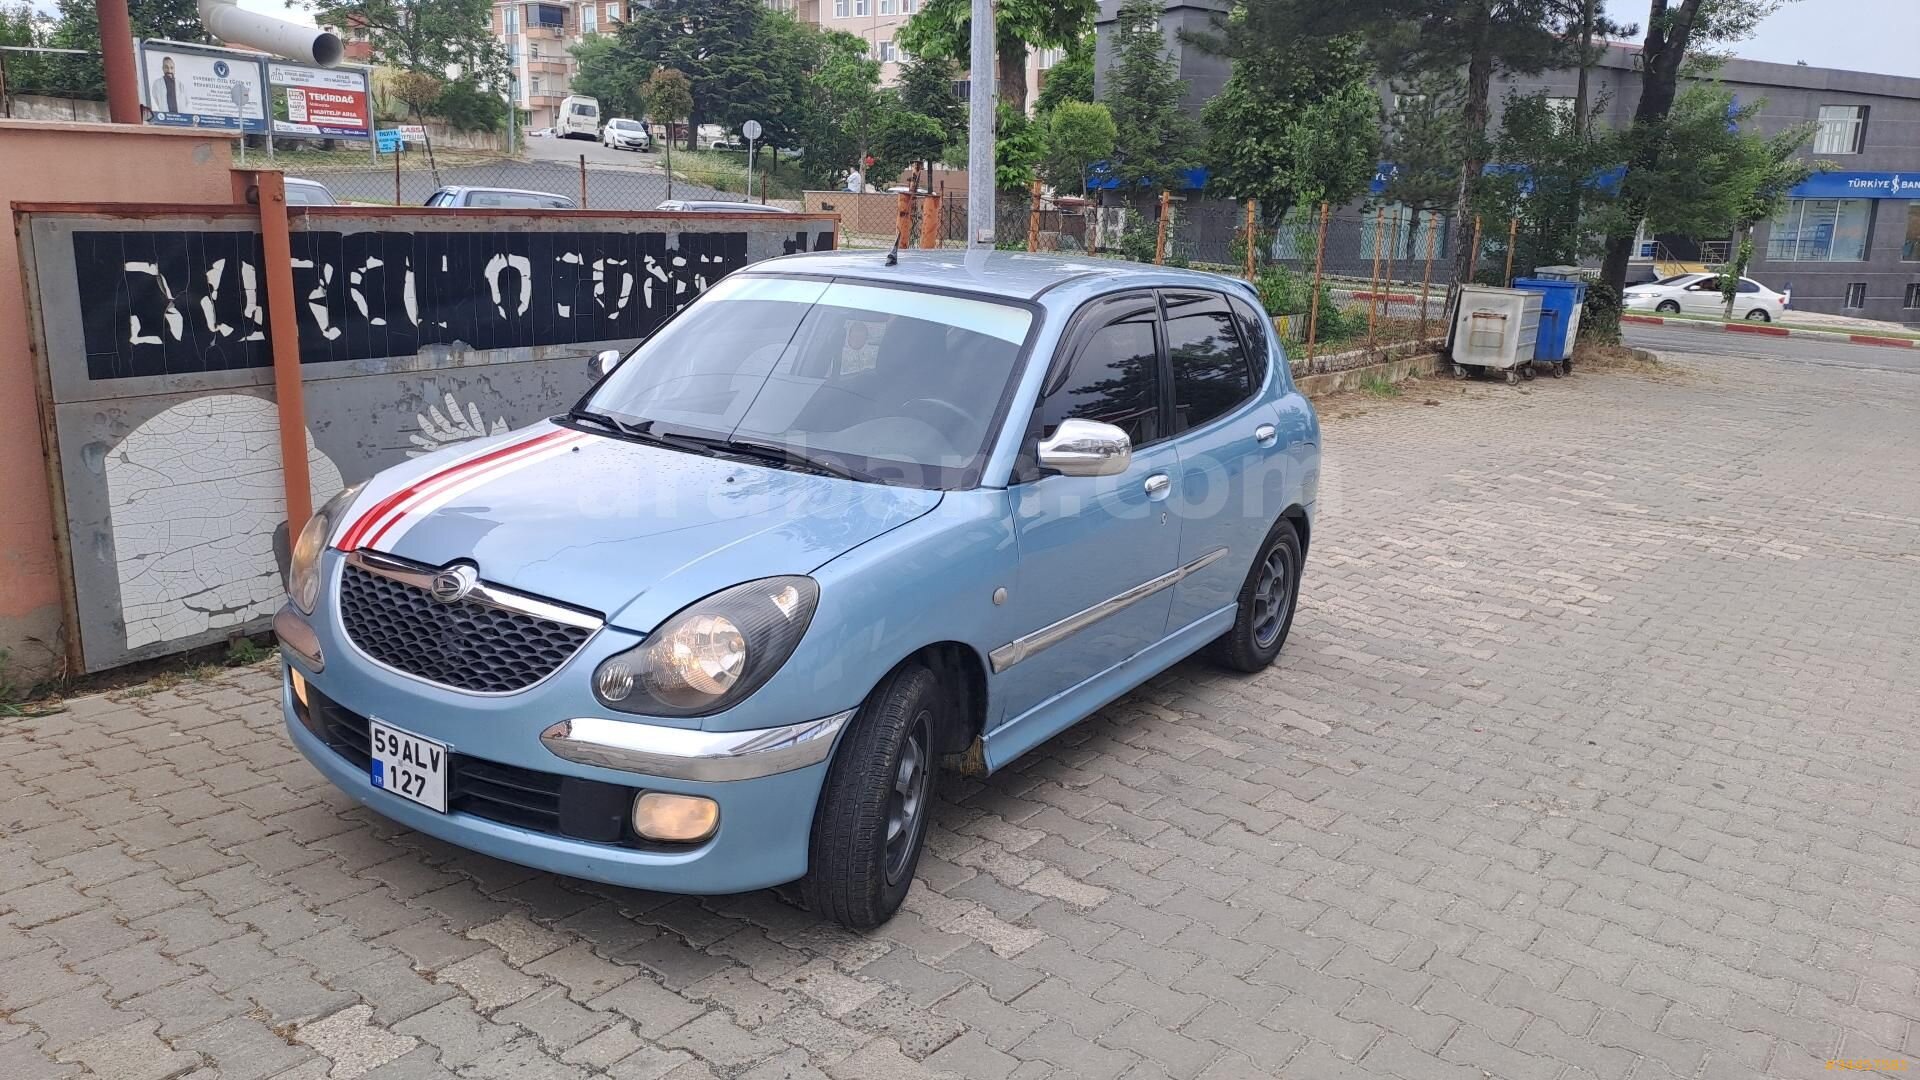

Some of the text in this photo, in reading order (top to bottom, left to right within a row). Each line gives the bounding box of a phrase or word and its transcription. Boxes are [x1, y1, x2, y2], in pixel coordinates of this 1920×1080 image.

[308, 92, 354, 104] TEKİRDAĞ
[1848, 178, 1890, 188] TÜRKİYE
[390, 766, 426, 798] 127
